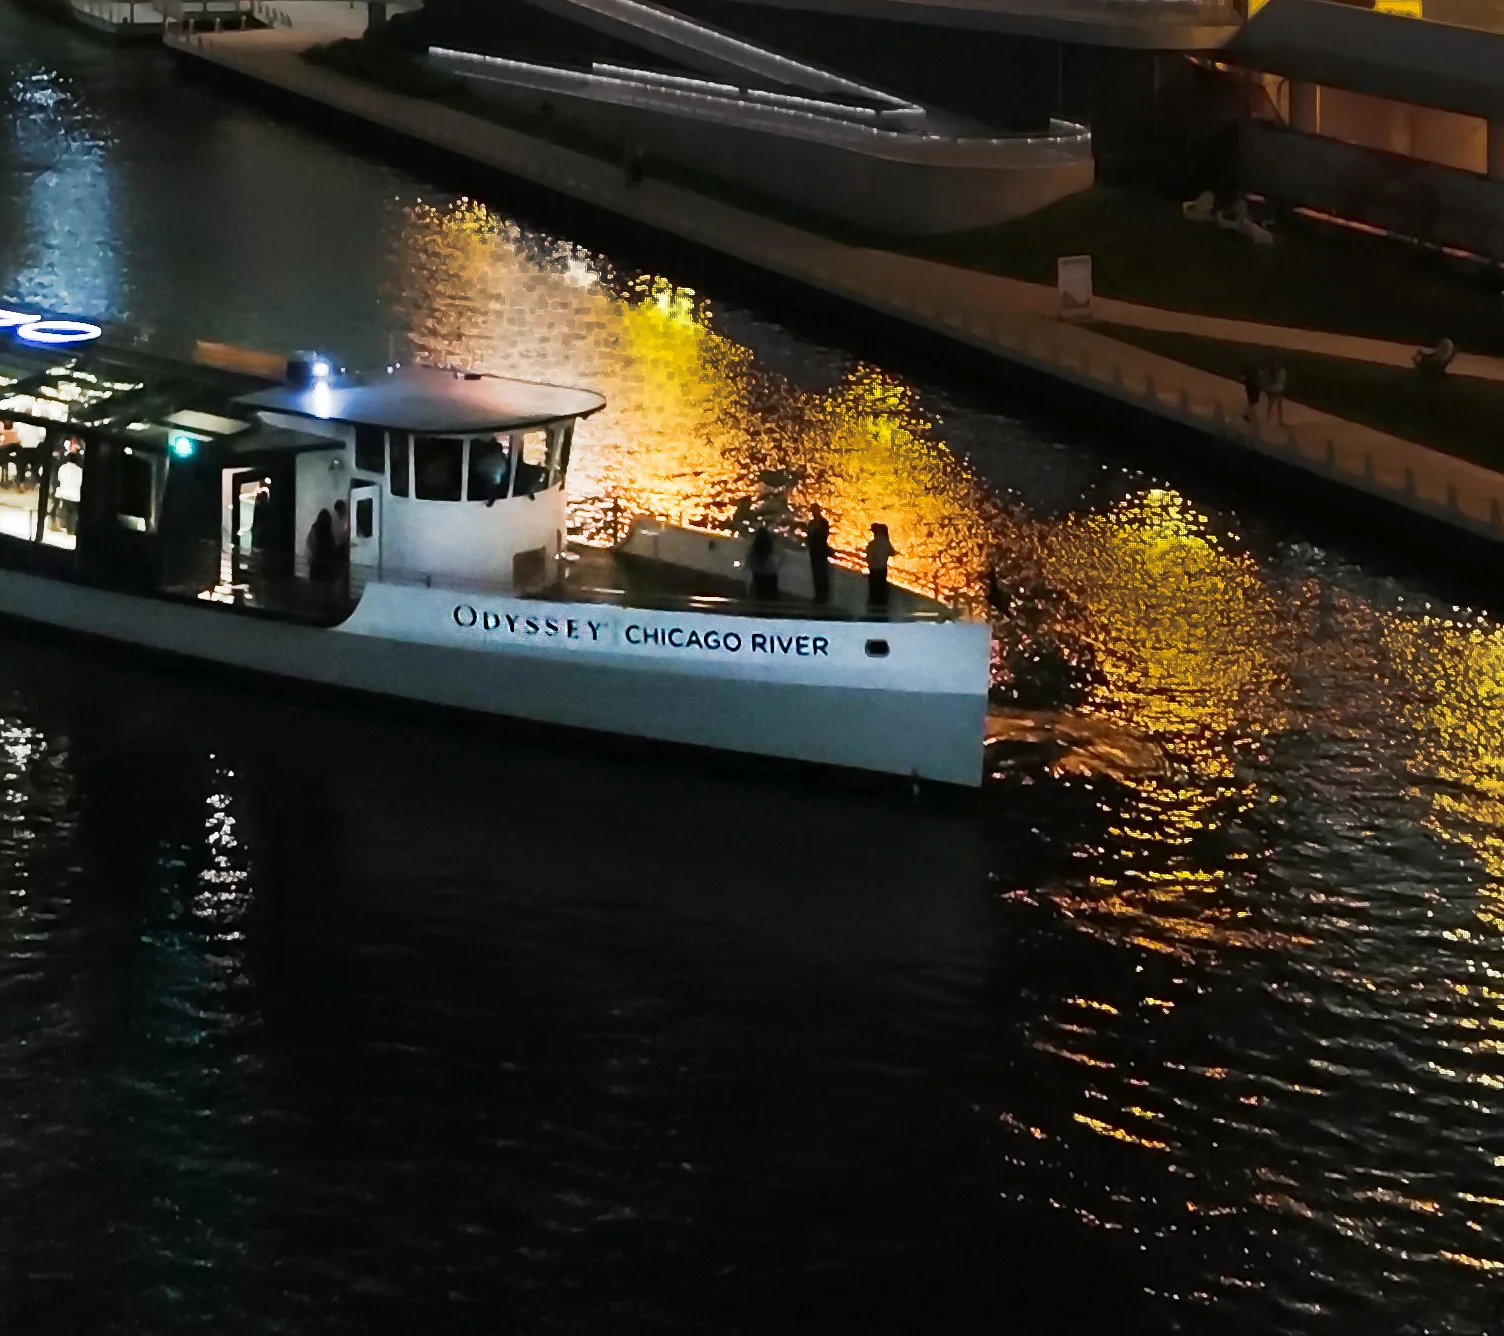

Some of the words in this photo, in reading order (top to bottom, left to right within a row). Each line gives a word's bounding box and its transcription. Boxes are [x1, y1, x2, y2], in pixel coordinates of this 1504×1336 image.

[453, 603, 603, 642] ODYSSEY
[624, 624, 742, 653] CHICAGO
[751, 632, 830, 657] RIVER
